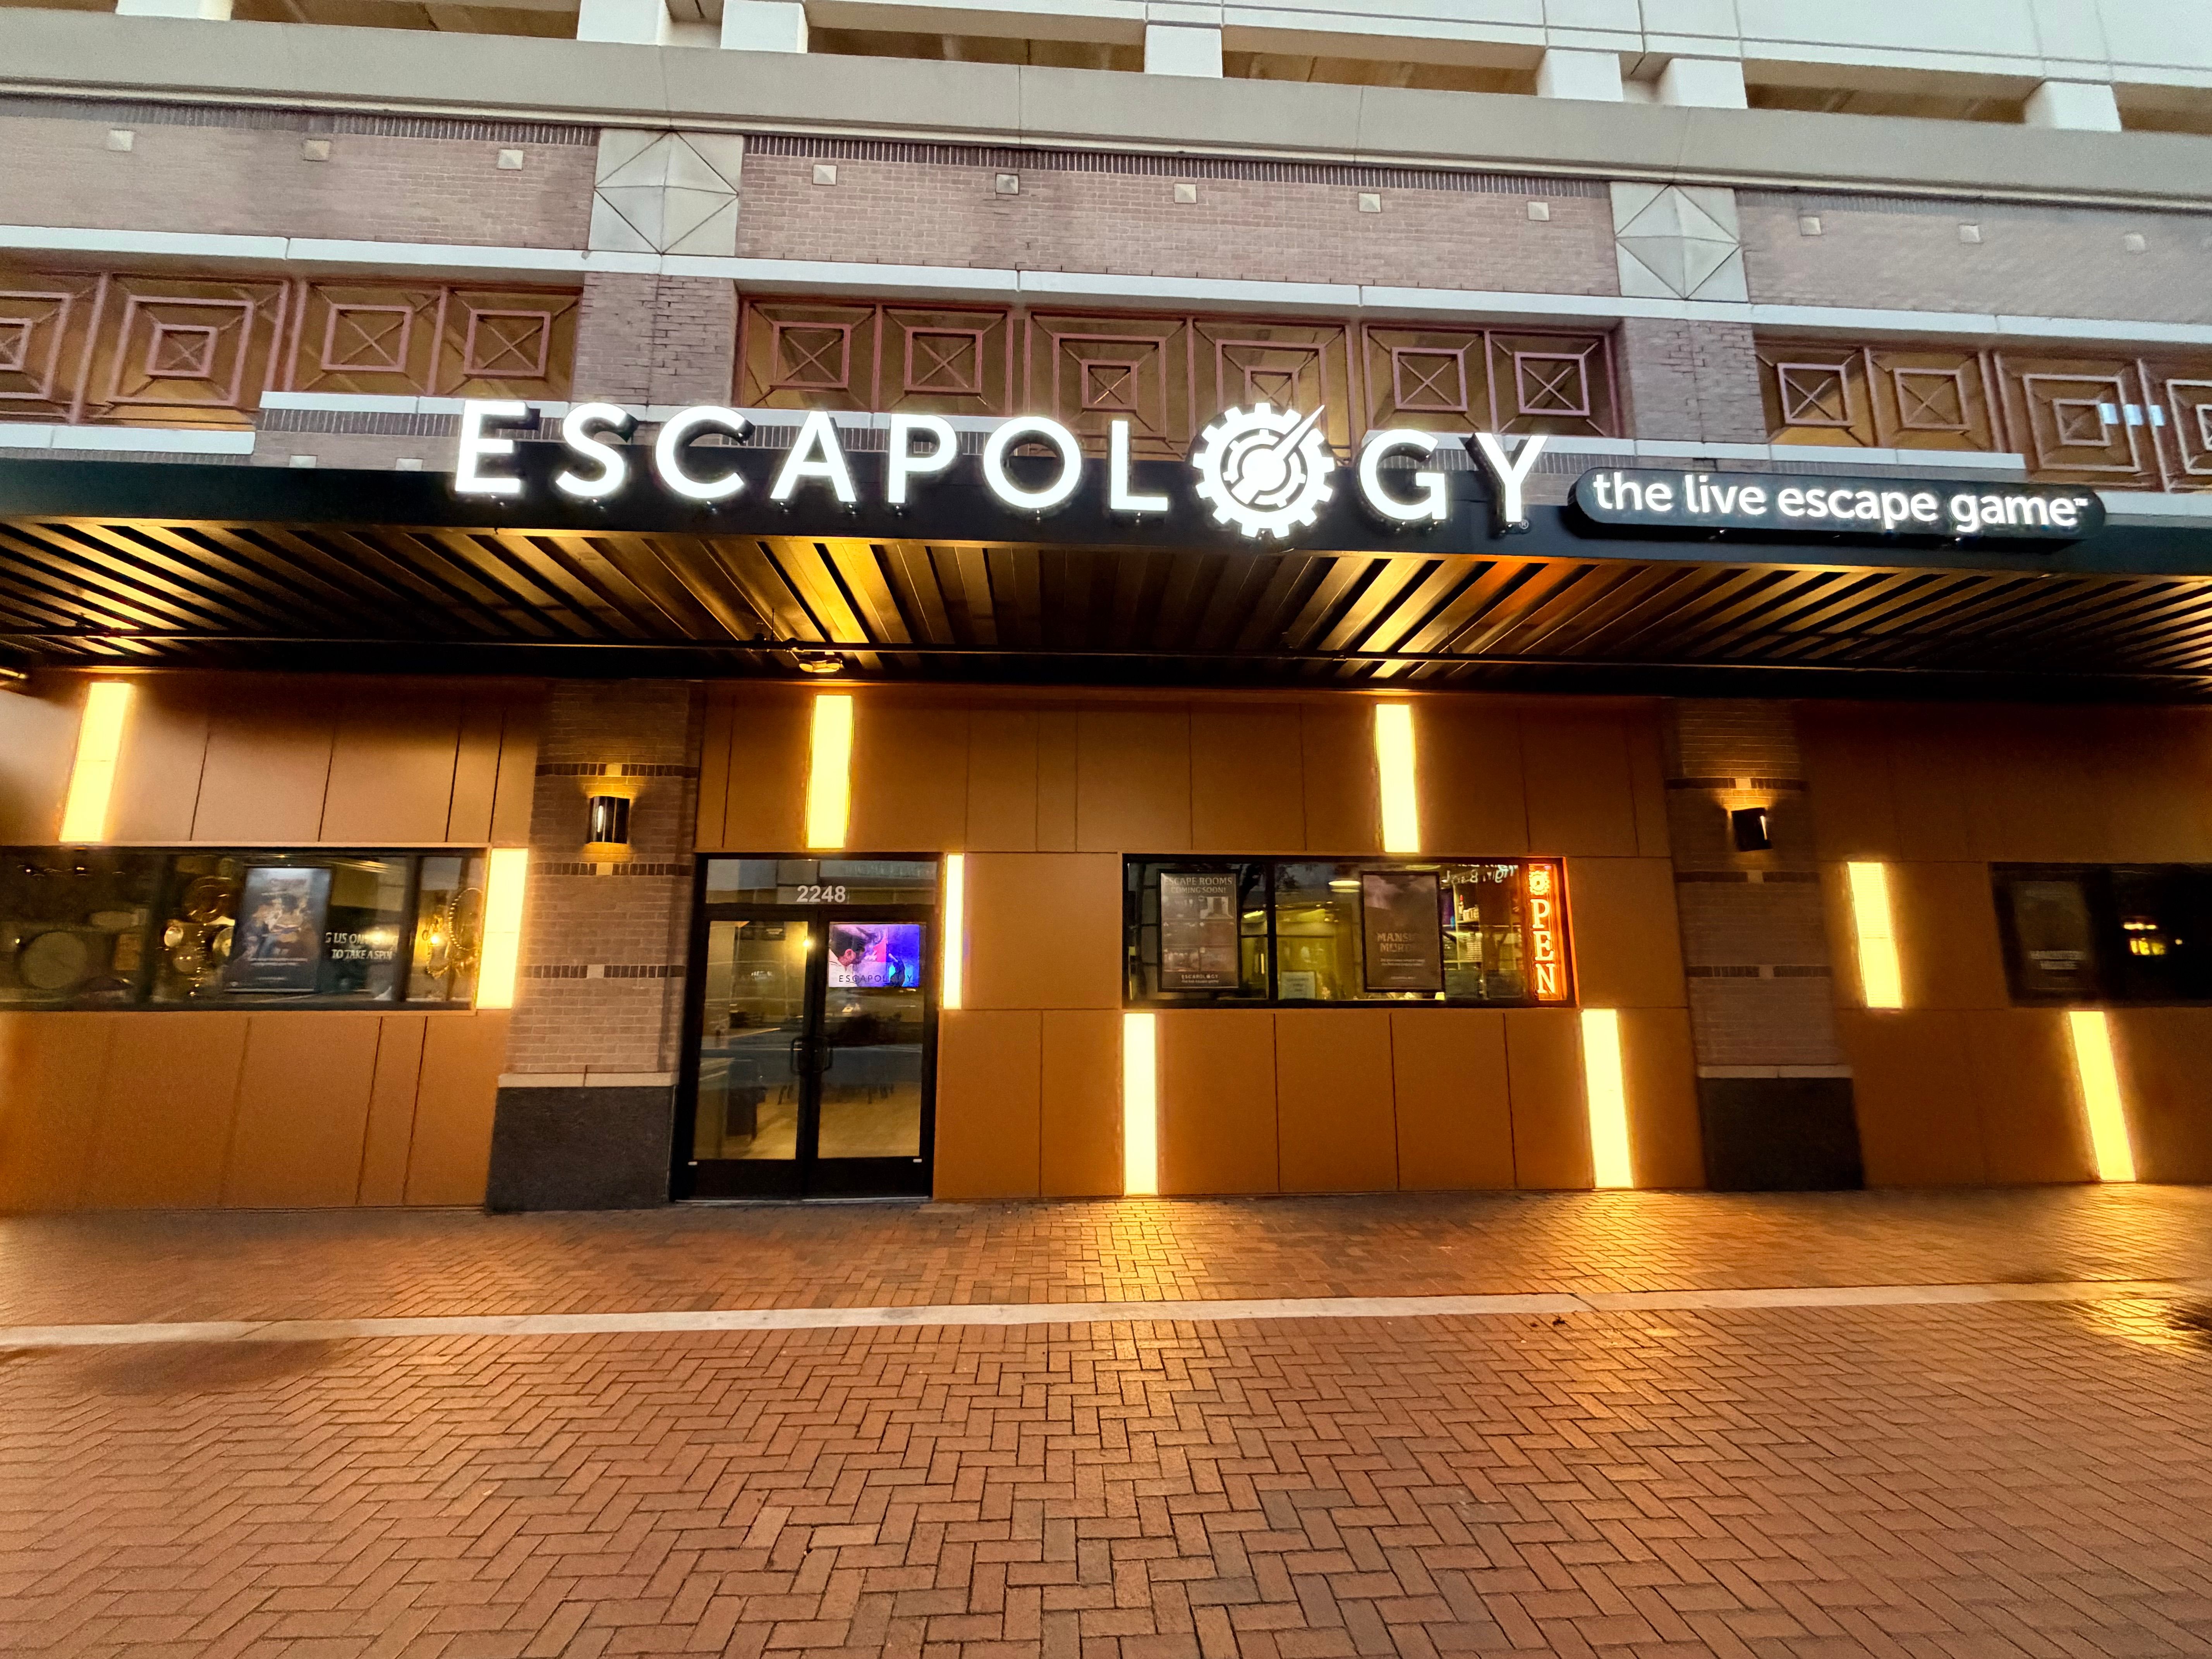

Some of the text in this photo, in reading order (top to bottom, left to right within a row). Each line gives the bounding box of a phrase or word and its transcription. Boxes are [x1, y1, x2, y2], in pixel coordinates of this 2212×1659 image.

[1593, 472, 1673, 512] the
[1685, 474, 1767, 515] live
[1778, 488, 1938, 530] escape
[1165, 877, 1233, 886] ESCAPE ROOMS
[797, 885, 846, 903] 2248
[334, 933, 348, 944] US
[1528, 871, 1556, 994] OPEN
[331, 949, 393, 961] TO TAKE A SPIN
